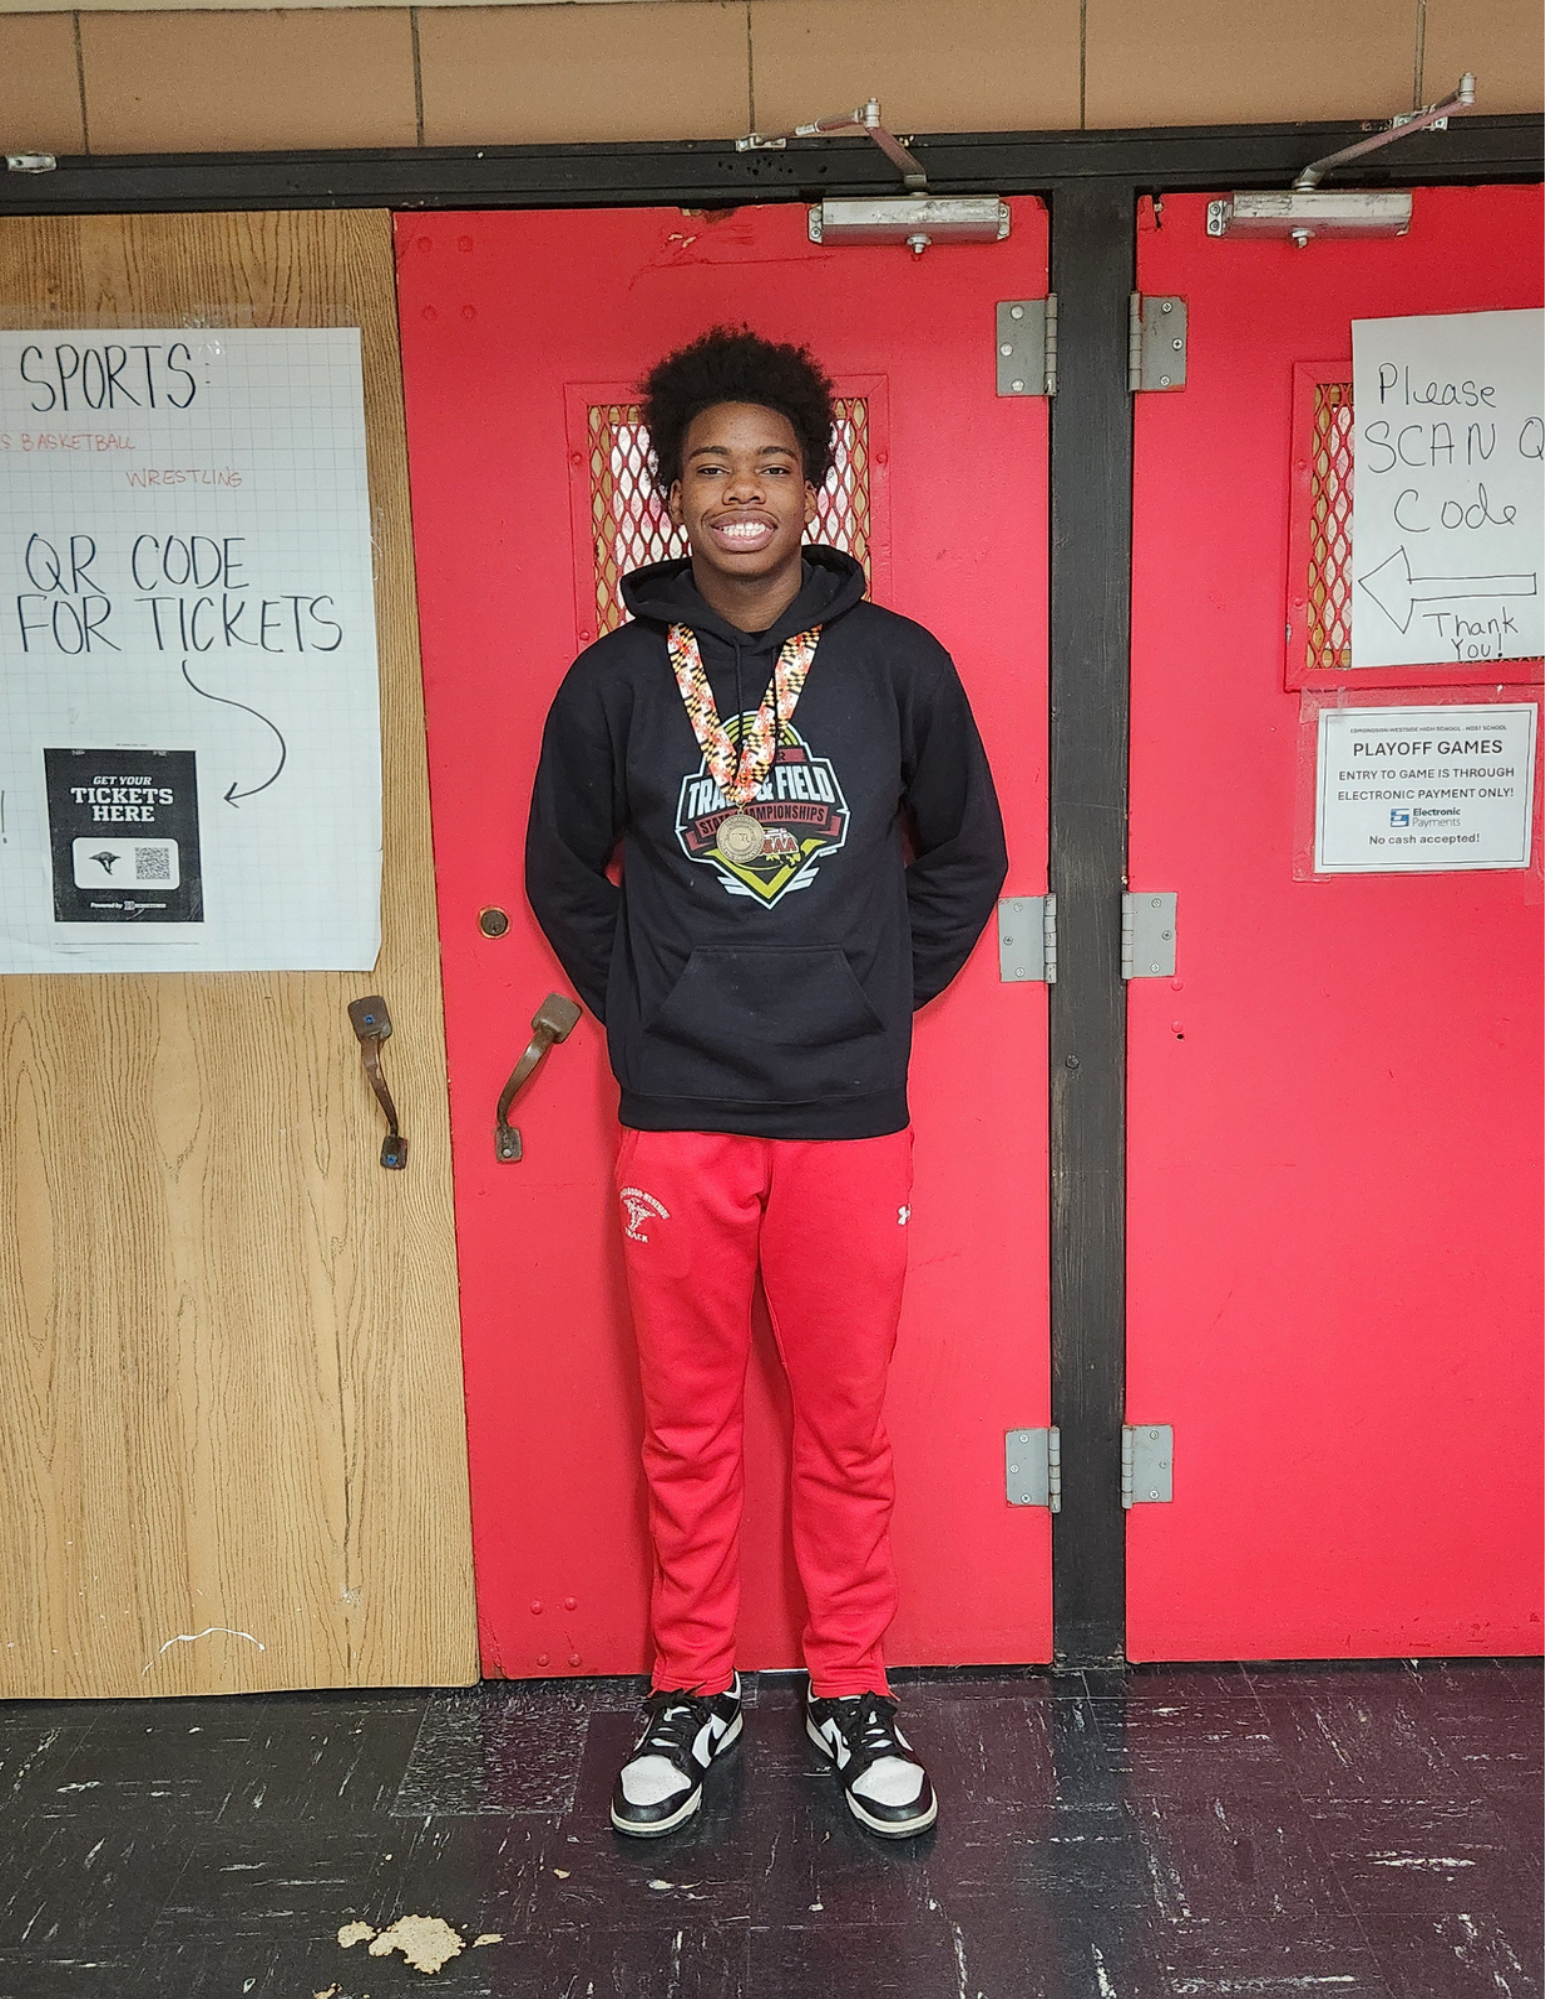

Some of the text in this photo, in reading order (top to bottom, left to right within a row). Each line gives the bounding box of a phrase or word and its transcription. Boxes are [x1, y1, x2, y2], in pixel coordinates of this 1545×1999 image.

[1378, 362, 1496, 408] Please
[21, 433, 136, 452] BASKETBALL
[1364, 416, 1545, 473] SCAN Q
[126, 467, 243, 488] WRESTLING
[1393, 482, 1517, 533] Code
[25, 533, 250, 595] QR CODE
[17, 593, 343, 655] FOR TICKETS
[1422, 606, 1518, 638] Thank
[1353, 740, 1503, 757] PLAYOFF GAMES
[93, 776, 152, 786] GET YOUR
[1339, 767, 1515, 781] ENTRY TO GAME IS THROUGH
[70, 787, 174, 805] TICKETS
[688, 778, 736, 819] TRA
[775, 765, 835, 803] FIELD
[1338, 787, 1514, 801] ELECTRONIC PAYMENT ONLY!
[92, 805, 155, 822] HERE
[1412, 807, 1461, 817] Electronic
[1412, 817, 1461, 829] Payments
[1369, 834, 1480, 846] No cash accepted!
